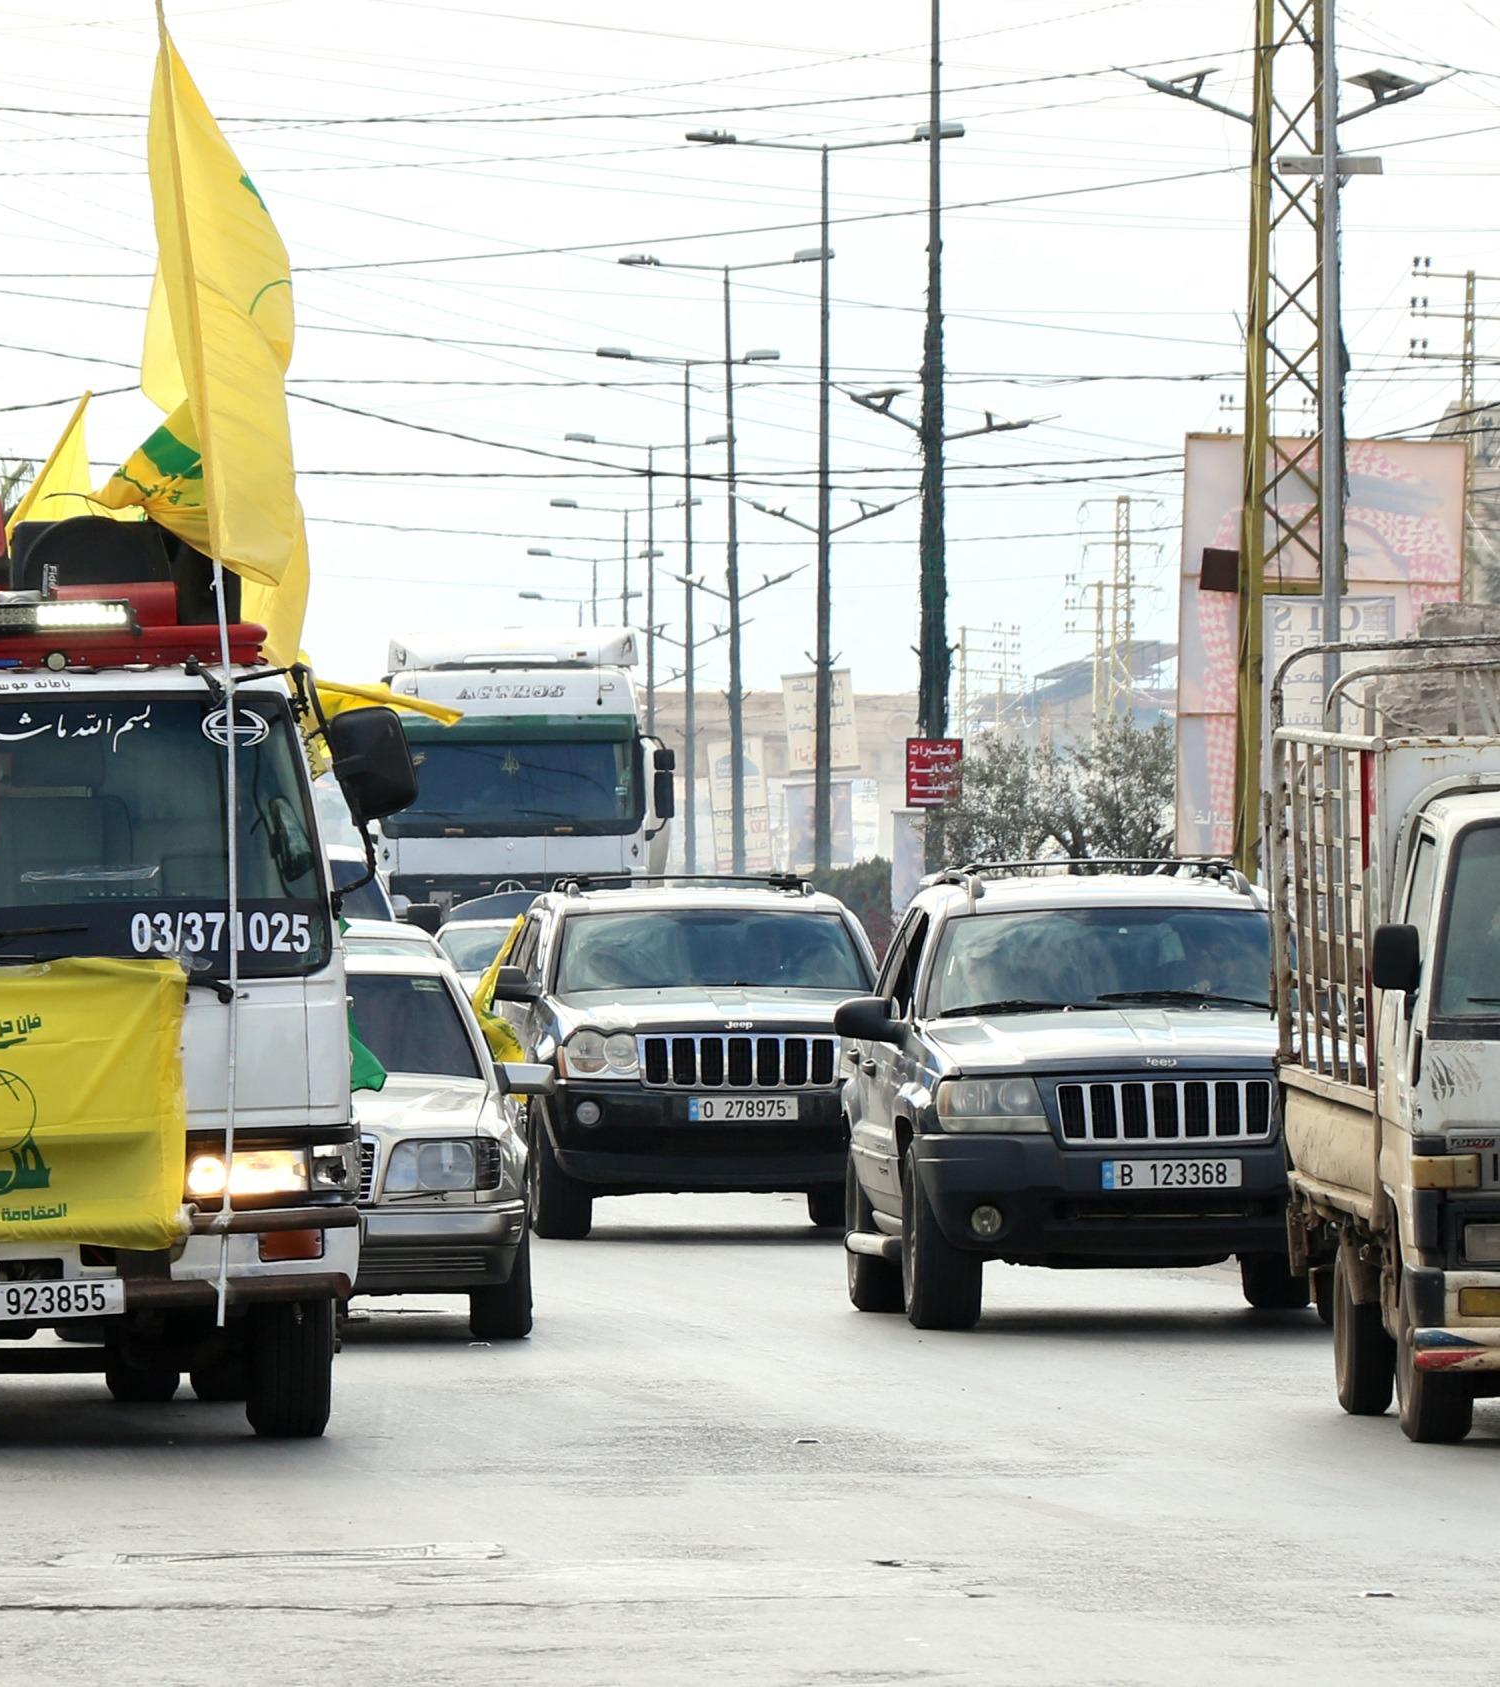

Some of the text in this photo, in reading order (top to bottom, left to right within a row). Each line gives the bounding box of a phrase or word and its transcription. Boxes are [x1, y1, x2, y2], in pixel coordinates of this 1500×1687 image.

[112, 703, 152, 753] بسم
[130, 911, 311, 953] 03/371025
[724, 1020, 754, 1030] Jeep
[1142, 1056, 1178, 1068] Jeep
[724, 1099, 787, 1119] 278975
[1450, 1137, 1496, 1149] TOYOTA
[1120, 1162, 1228, 1187] B 123368
[1, 1203, 68, 1223] المقاومة
[6, 1283, 106, 1316] 923855
